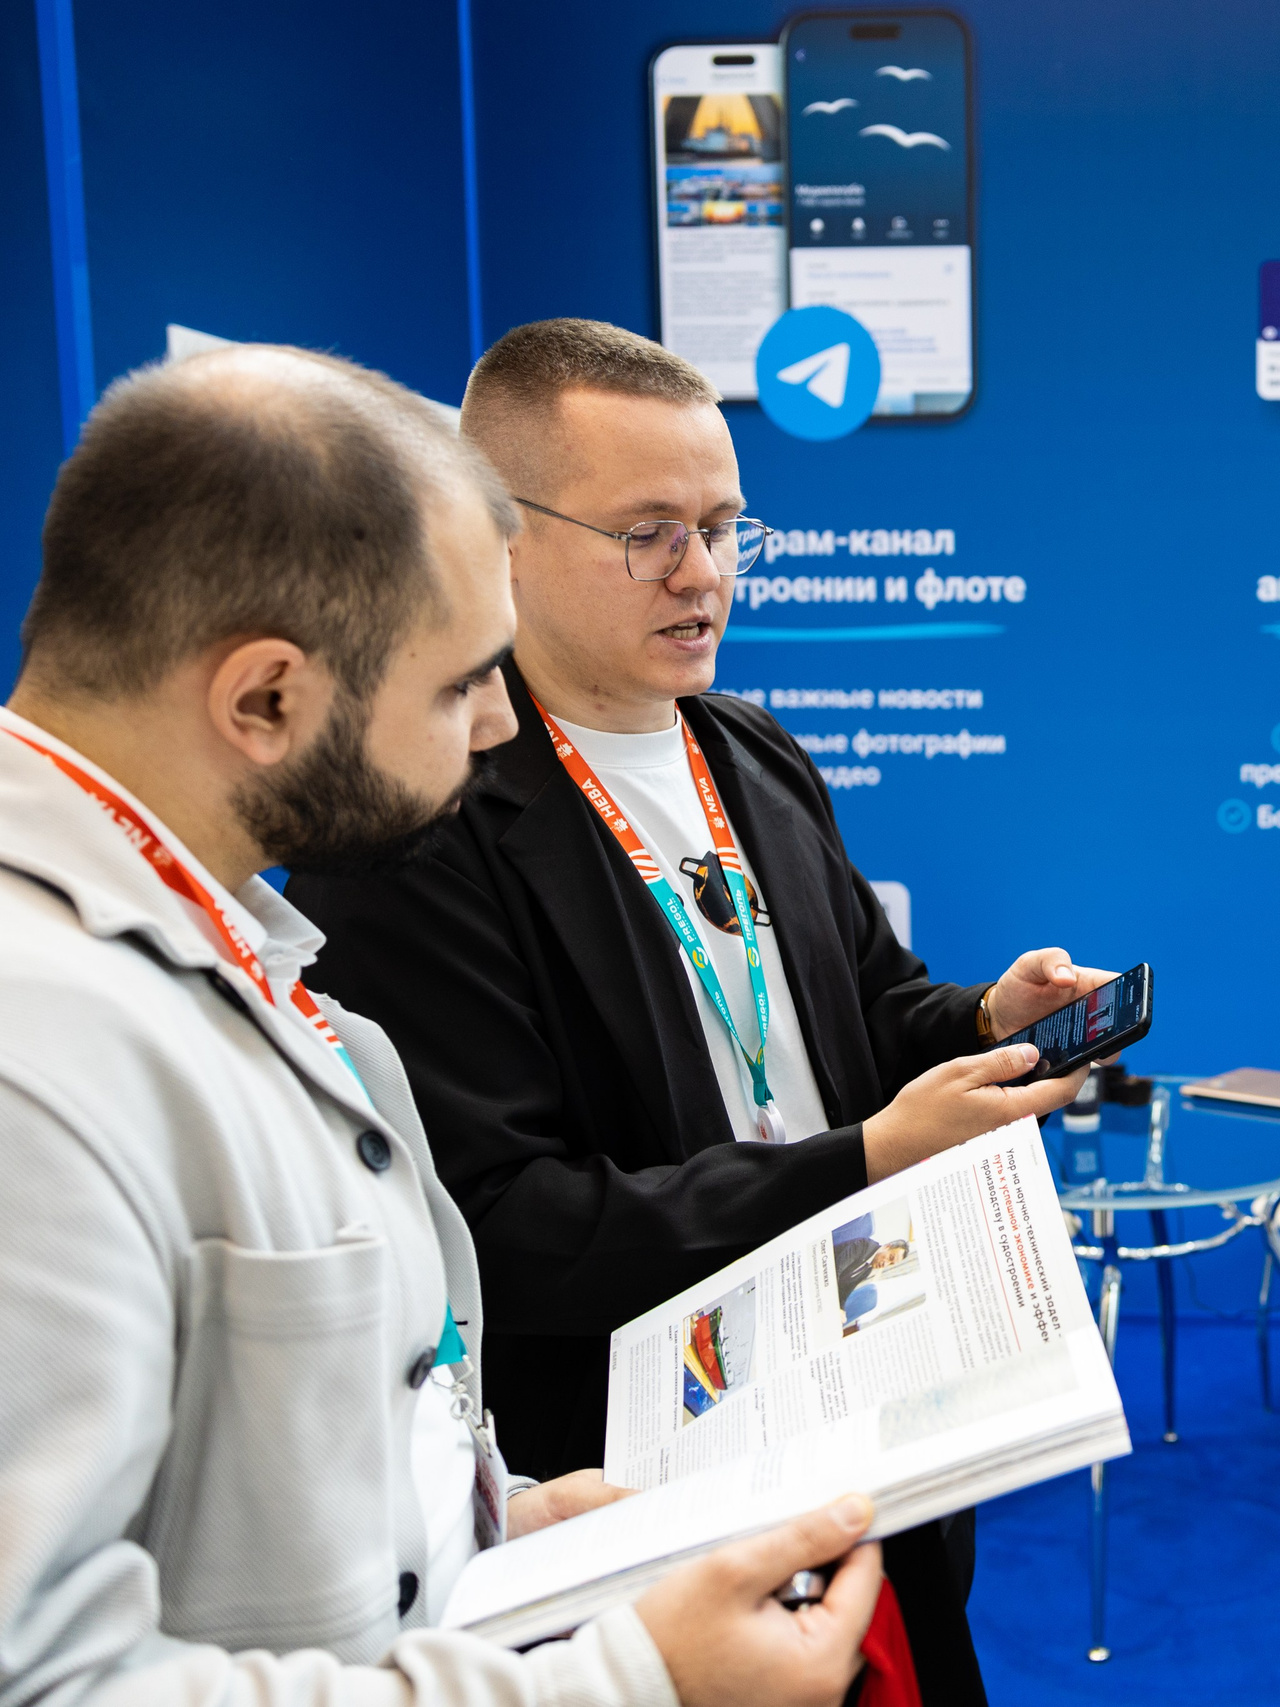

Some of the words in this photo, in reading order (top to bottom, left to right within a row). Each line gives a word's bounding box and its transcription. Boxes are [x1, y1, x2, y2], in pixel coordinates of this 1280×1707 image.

[885, 576, 908, 602] и
[915, 567, 1027, 610] флоте
[769, 688, 875, 709] важные
[878, 688, 983, 709] новости
[851, 728, 1006, 760] фотографии
[581, 778, 616, 818] НЕВА
[698, 776, 719, 814] NEVA
[666, 897, 696, 943] PREGOL
[1005, 1147, 1017, 1171] Упор
[1012, 1172, 1021, 1185] на
[981, 1158, 1003, 1225] производству
[999, 1233, 1025, 1309] судостроении
[993, 1153, 1002, 1175] путь
[999, 1184, 1018, 1232] успешной
[1014, 1234, 1035, 1290] экономике
[1016, 1187, 1050, 1292] научно-технический
[1045, 1294, 1061, 1332] задел
